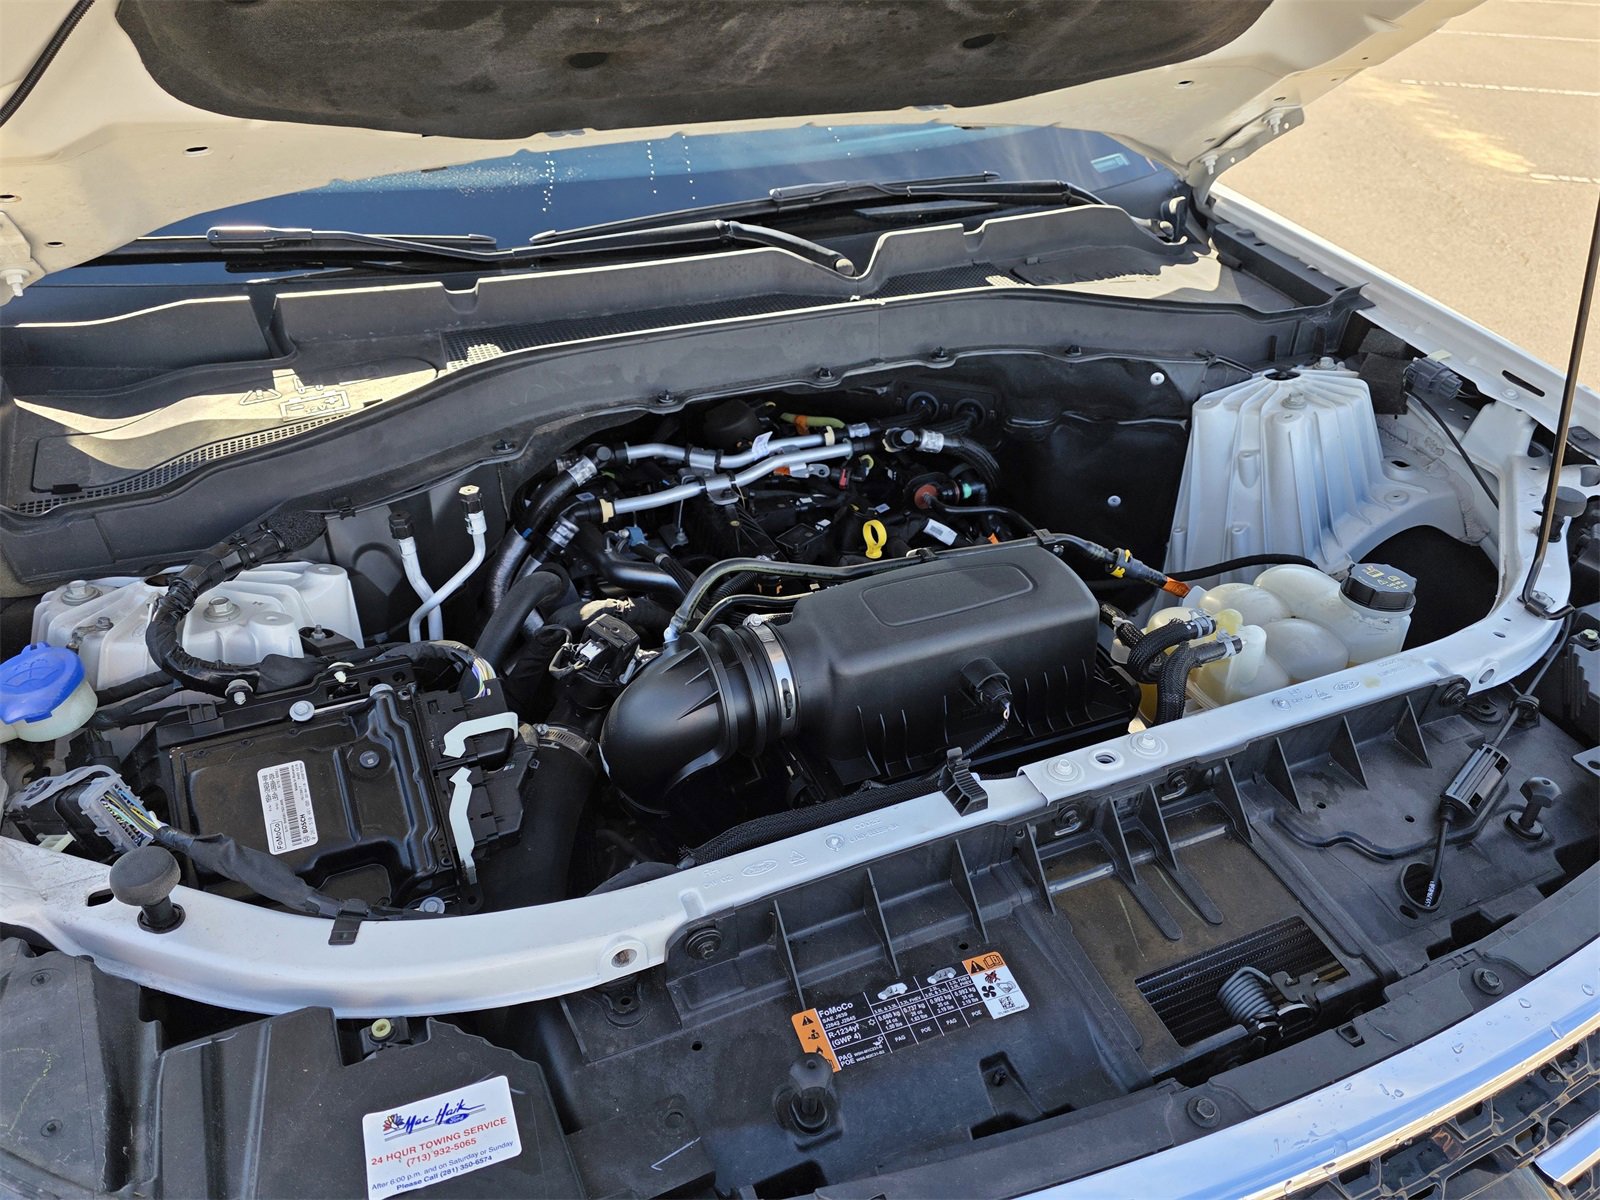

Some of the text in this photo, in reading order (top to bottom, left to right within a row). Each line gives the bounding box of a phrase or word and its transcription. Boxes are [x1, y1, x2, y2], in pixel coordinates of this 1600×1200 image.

[300, 814, 308, 834] BOSCH
[274, 823, 284, 850] FoMoCo
[818, 1002, 854, 1018] FoMoCo
[903, 1004, 917, 1014] 0.737
[822, 1012, 848, 1024] SAE J639
[828, 1023, 860, 1039] R-1234yf
[832, 1036, 852, 1048] (GWP
[838, 1052, 853, 1062] PAG
[840, 1059, 855, 1067] POE
[404, 1099, 473, 1134] Mac Haik
[448, 1114, 468, 1124] Ford
[371, 1116, 508, 1166] 24 HOUR TOWING SERVICE
[406, 1138, 477, 1168] (713) 932-5065
[372, 1180, 388, 1190] After
[390, 1176, 406, 1186] 6:00
[407, 1171, 422, 1181] p.m.
[424, 1166, 437, 1175] and
[448, 1152, 478, 1166] Saturday
[488, 1140, 514, 1153] Sunday
[396, 1155, 492, 1191] Please Call (281) 350-6574
